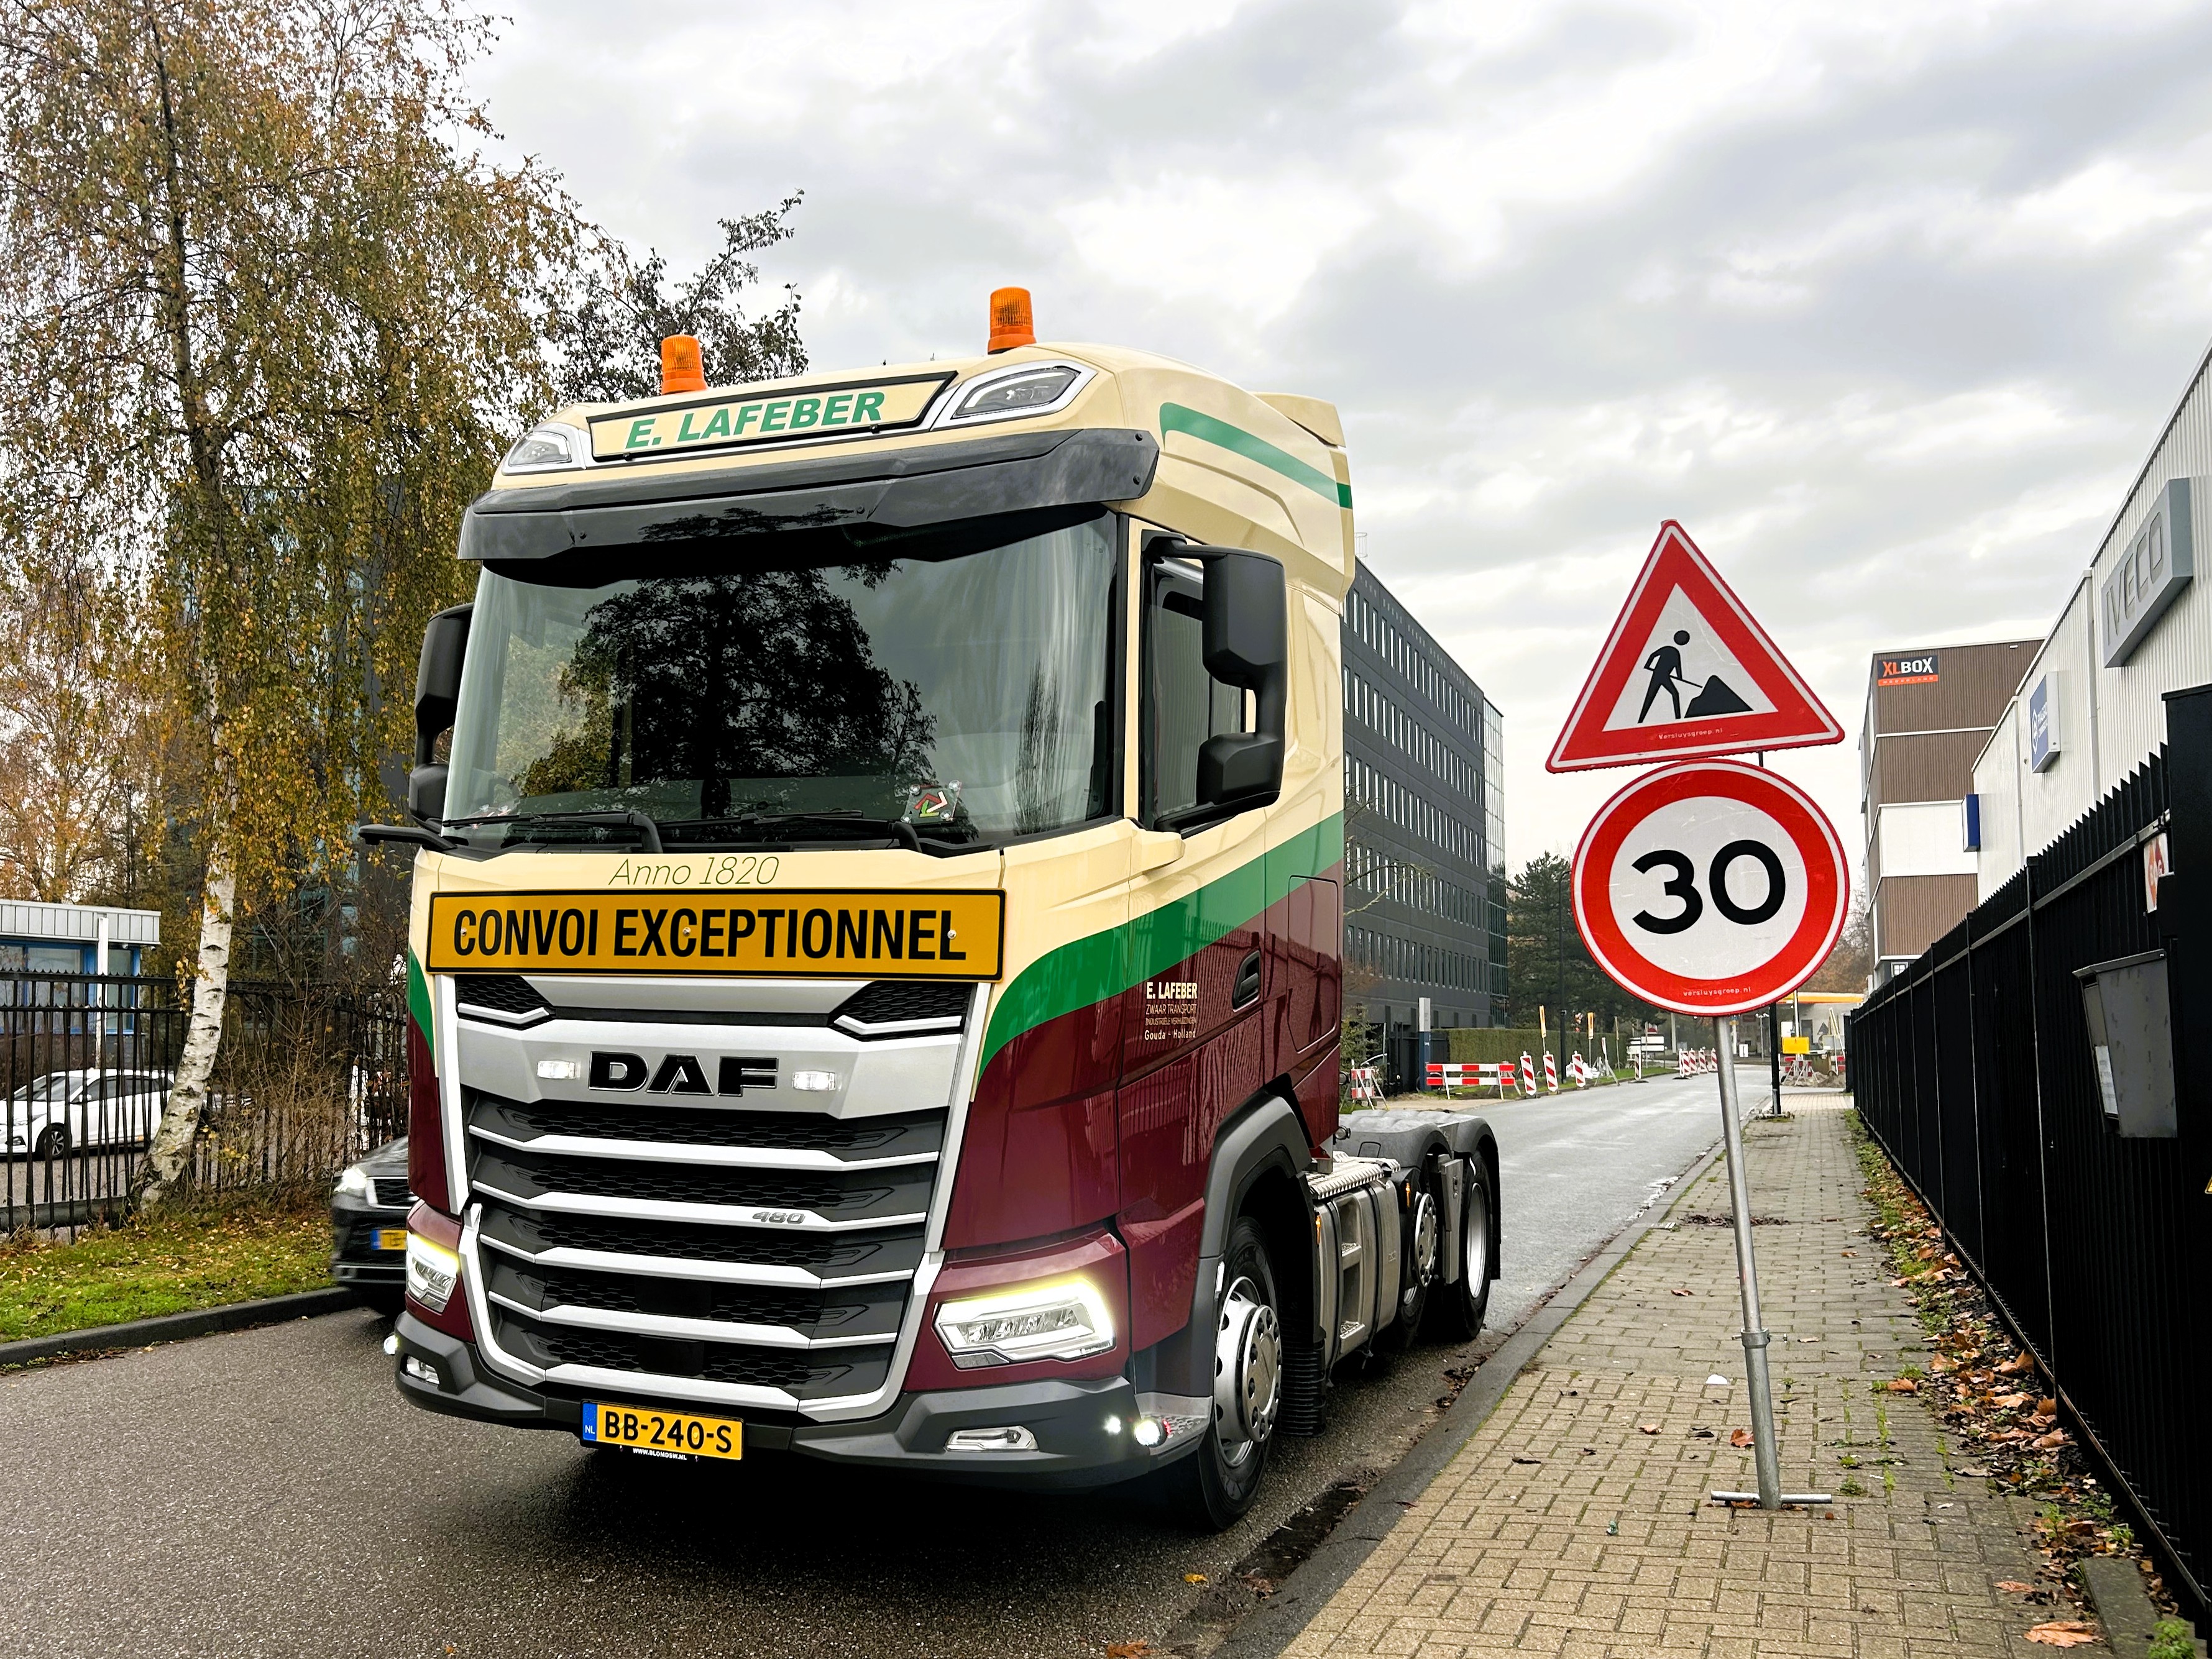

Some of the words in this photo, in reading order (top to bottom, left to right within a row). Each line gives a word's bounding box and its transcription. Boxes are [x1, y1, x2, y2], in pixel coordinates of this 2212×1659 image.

[625, 418, 661, 449] E.
[677, 391, 885, 442] LAFEBER
[2106, 511, 2163, 646] IVECO
[608, 858, 691, 885] Anno
[699, 856, 779, 885] 1820
[1631, 839, 1786, 935] 30
[454, 909, 599, 957] CONVOI
[613, 908, 967, 961] EXCEPTIONNEL
[1145, 1003, 1167, 1015] ZWAAR
[1168, 1003, 1197, 1015] TRANSPORT
[1146, 982, 1156, 999] E.
[1158, 982, 1198, 999] LAFEBER
[1144, 1029, 1166, 1041] Gouda
[1173, 1028, 1196, 1039] Holland
[588, 1051, 779, 1097] DAF
[752, 1211, 805, 1224] 480
[585, 1424, 595, 1435] NL
[605, 1410, 732, 1453] BB-240-S
